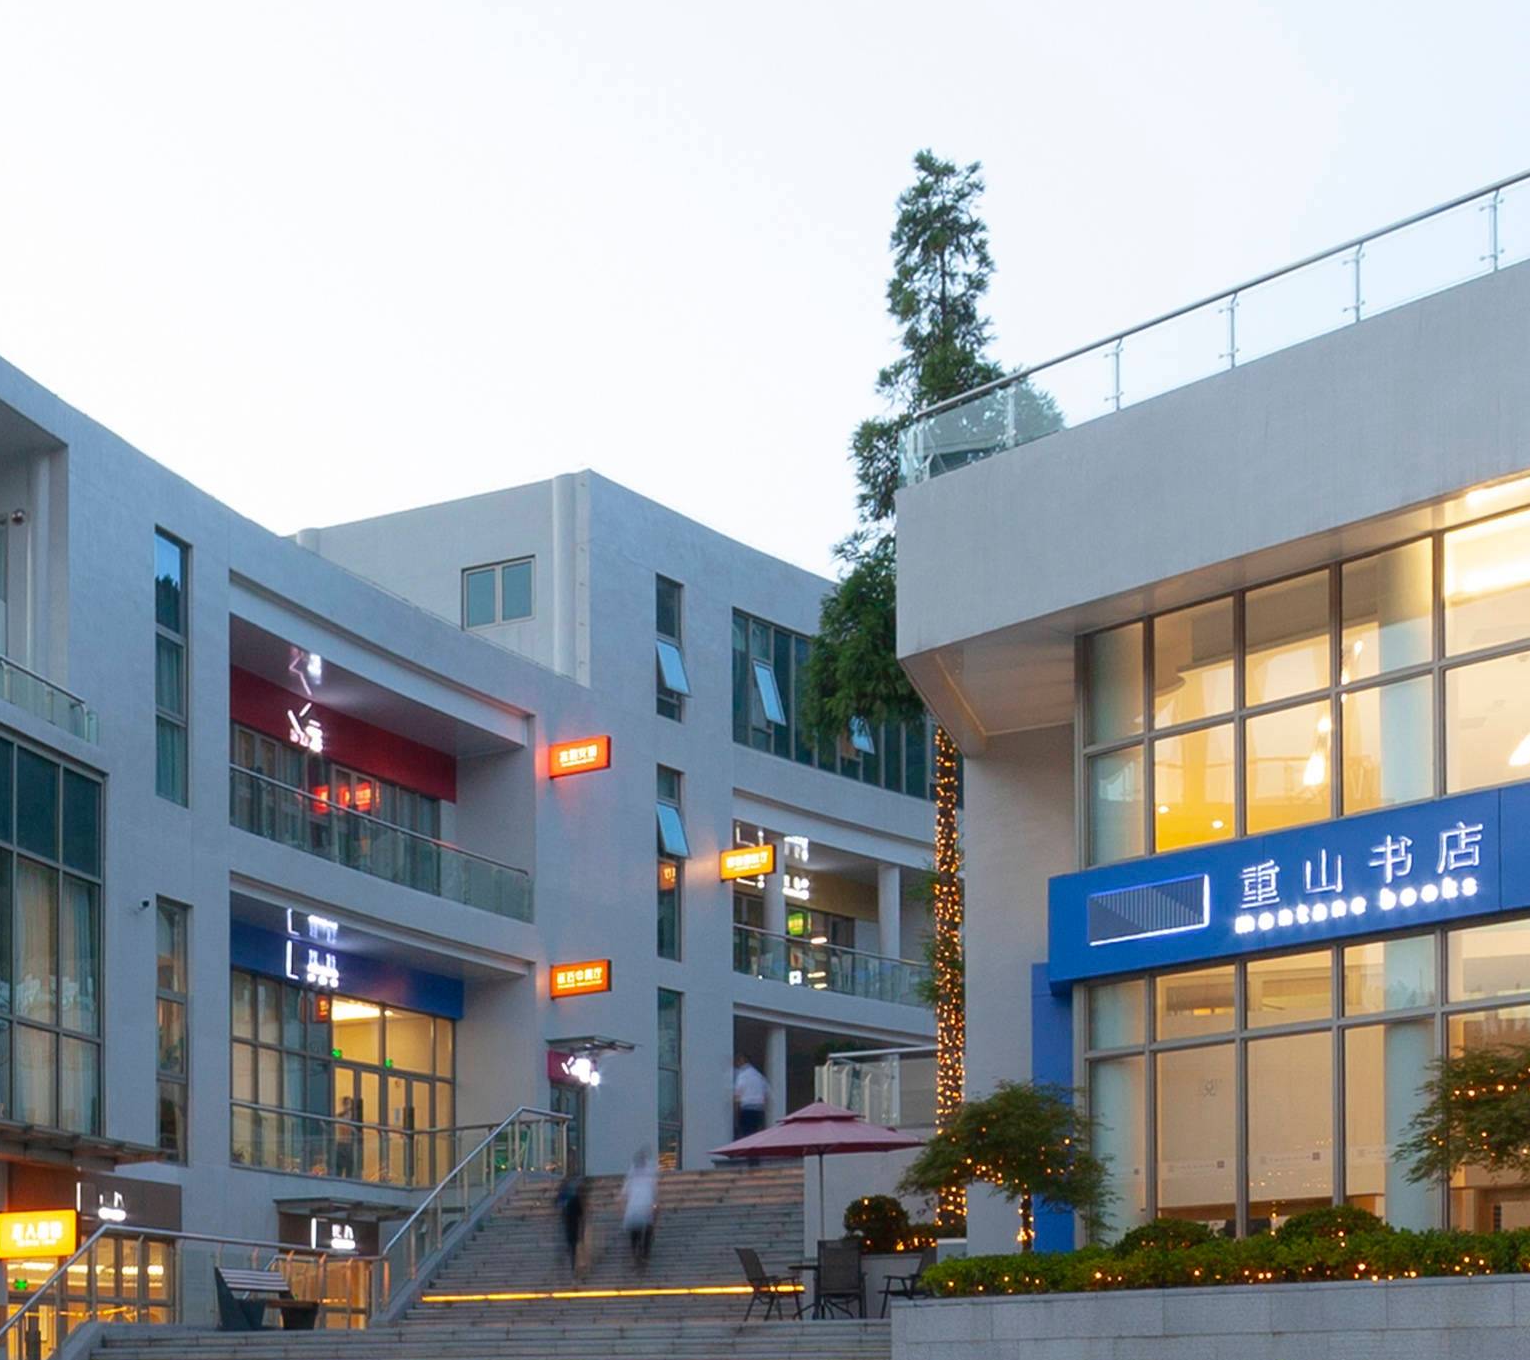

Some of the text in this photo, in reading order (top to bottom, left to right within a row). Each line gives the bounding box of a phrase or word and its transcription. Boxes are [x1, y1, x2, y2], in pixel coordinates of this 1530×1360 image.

[1239, 821, 1484, 909] 重山书店
[1378, 875, 1478, 912] books
